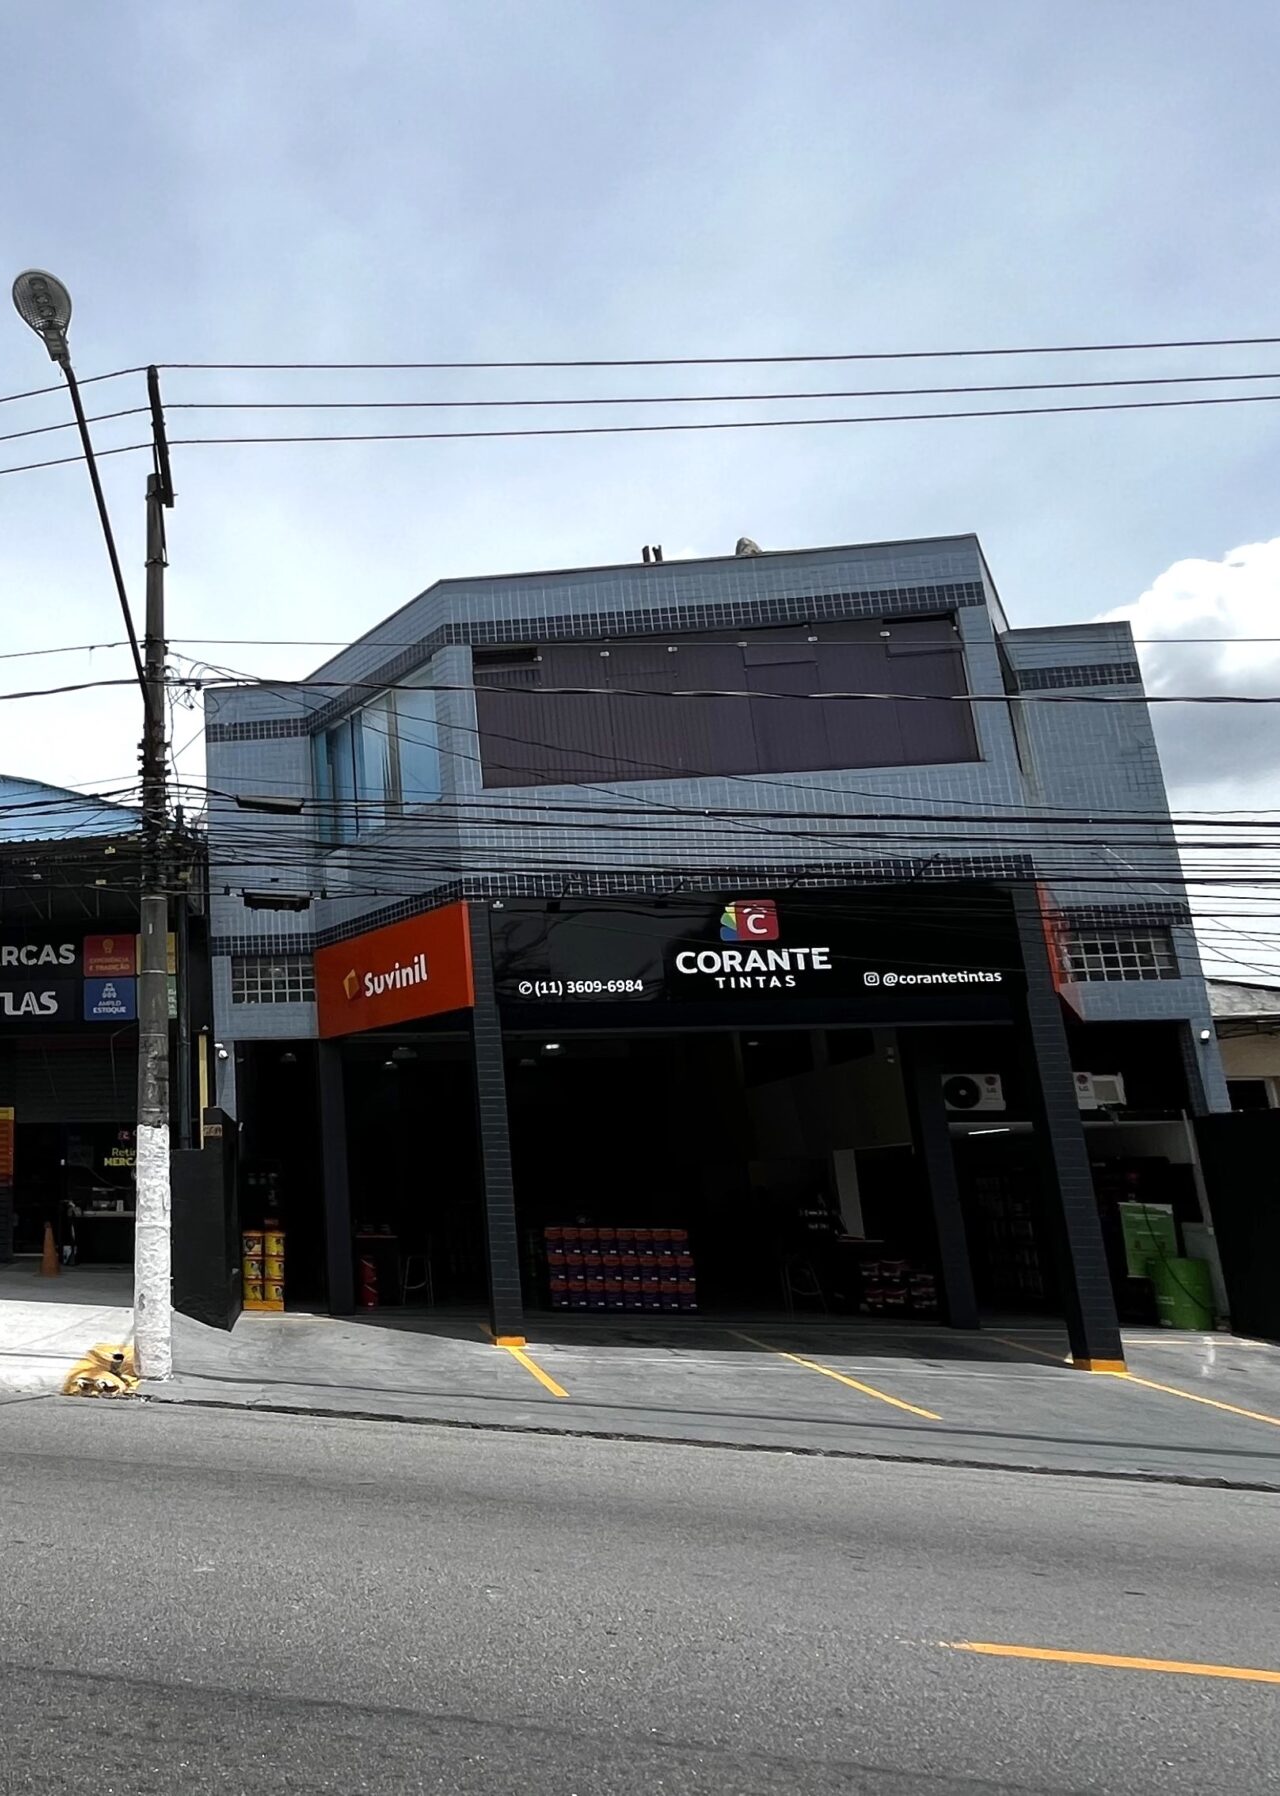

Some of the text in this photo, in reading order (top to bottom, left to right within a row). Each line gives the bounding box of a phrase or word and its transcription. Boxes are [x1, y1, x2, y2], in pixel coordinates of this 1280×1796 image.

[675, 946, 833, 975] CORANTE
[363, 952, 428, 998] Suvinil
[714, 975, 798, 990] TINTAS
[882, 970, 1003, 987] @corantetintas
[534, 979, 644, 998] (11) 3609-6984
[92, 1006, 127, 1014] ESTOQUE
